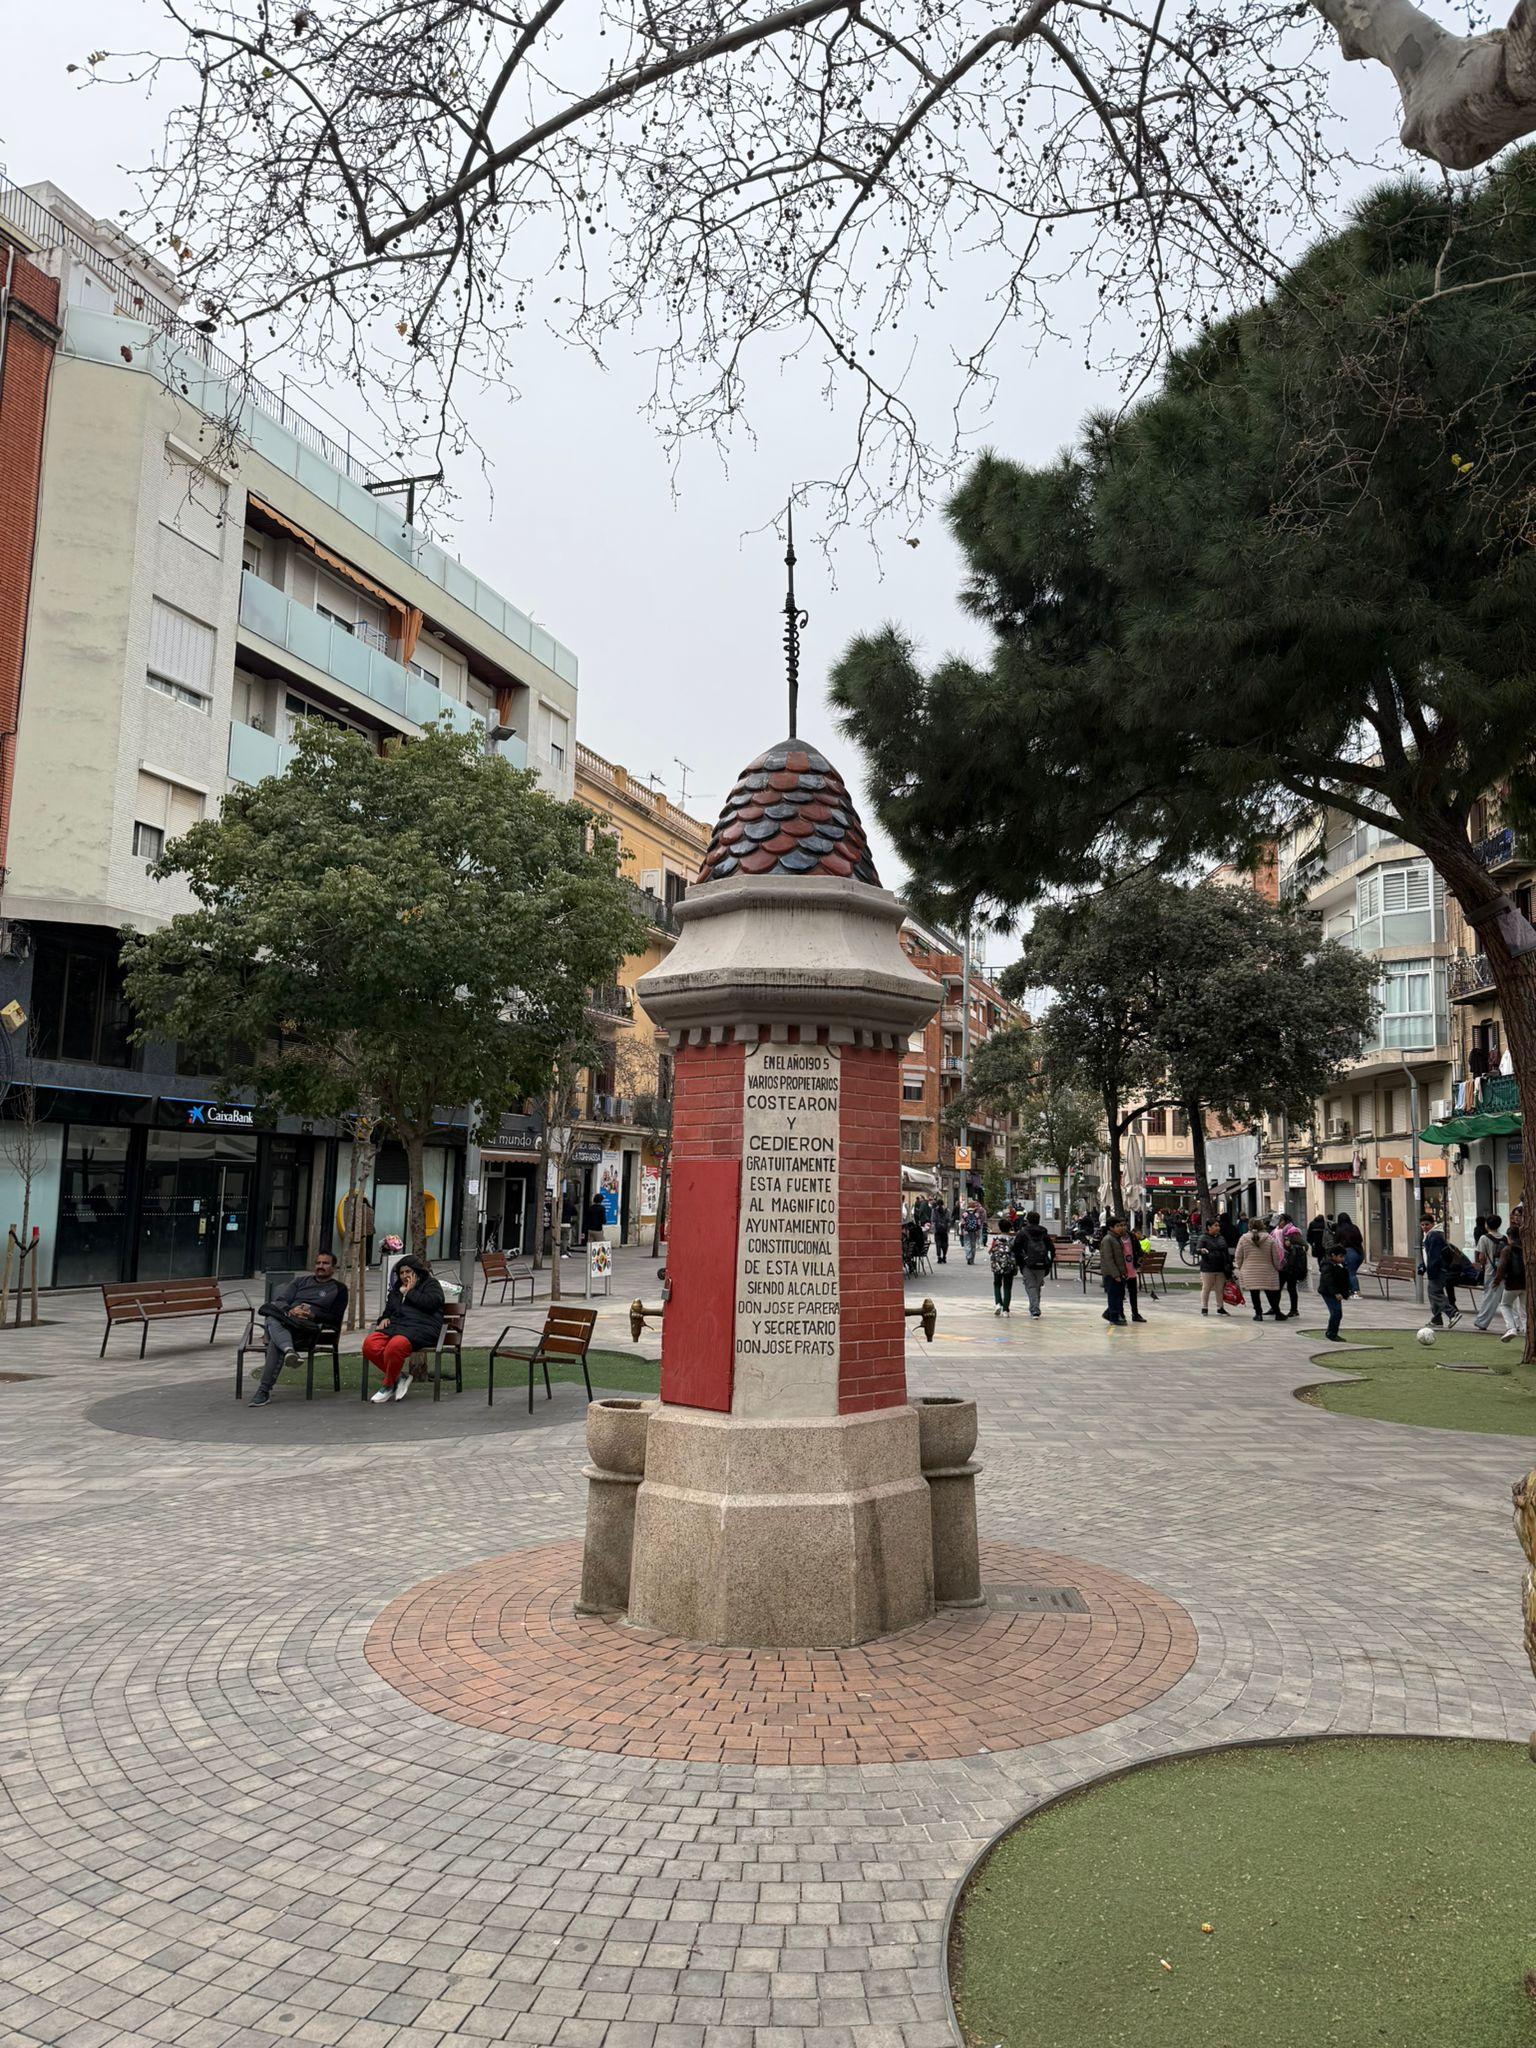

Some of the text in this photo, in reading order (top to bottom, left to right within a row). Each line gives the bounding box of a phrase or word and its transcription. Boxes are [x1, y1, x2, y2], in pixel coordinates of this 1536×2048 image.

[763, 1055, 776, 1070] EN
[776, 1056, 786, 1070] EL
[786, 1053, 806, 1070] AÑO
[748, 1075, 839, 1091] VARIOS PROPIETARIOS
[747, 1095, 837, 1111] COSTEARON
[207, 1107, 254, 1124] CaixaBank
[786, 1116, 797, 1130] Y
[499, 1132, 532, 1148] mundo
[749, 1135, 834, 1152] CEDIERON
[746, 1155, 836, 1172] GRATUITAMENTE
[750, 1176, 832, 1193] ESTA FUENTE
[749, 1197, 835, 1213] AL MAGNIFICO
[745, 1218, 836, 1235] AYUNTAMIENTO
[748, 1238, 832, 1255] CONSTITUCIONAL
[744, 1260, 836, 1277] DE ESTA VILLA
[747, 1281, 838, 1296] SIENDO ALCALDE
[738, 1300, 840, 1315] DON JOSE PARERA
[752, 1320, 836, 1335] Y SECRETARIO
[736, 1339, 835, 1356] DON JOSE PRATS
